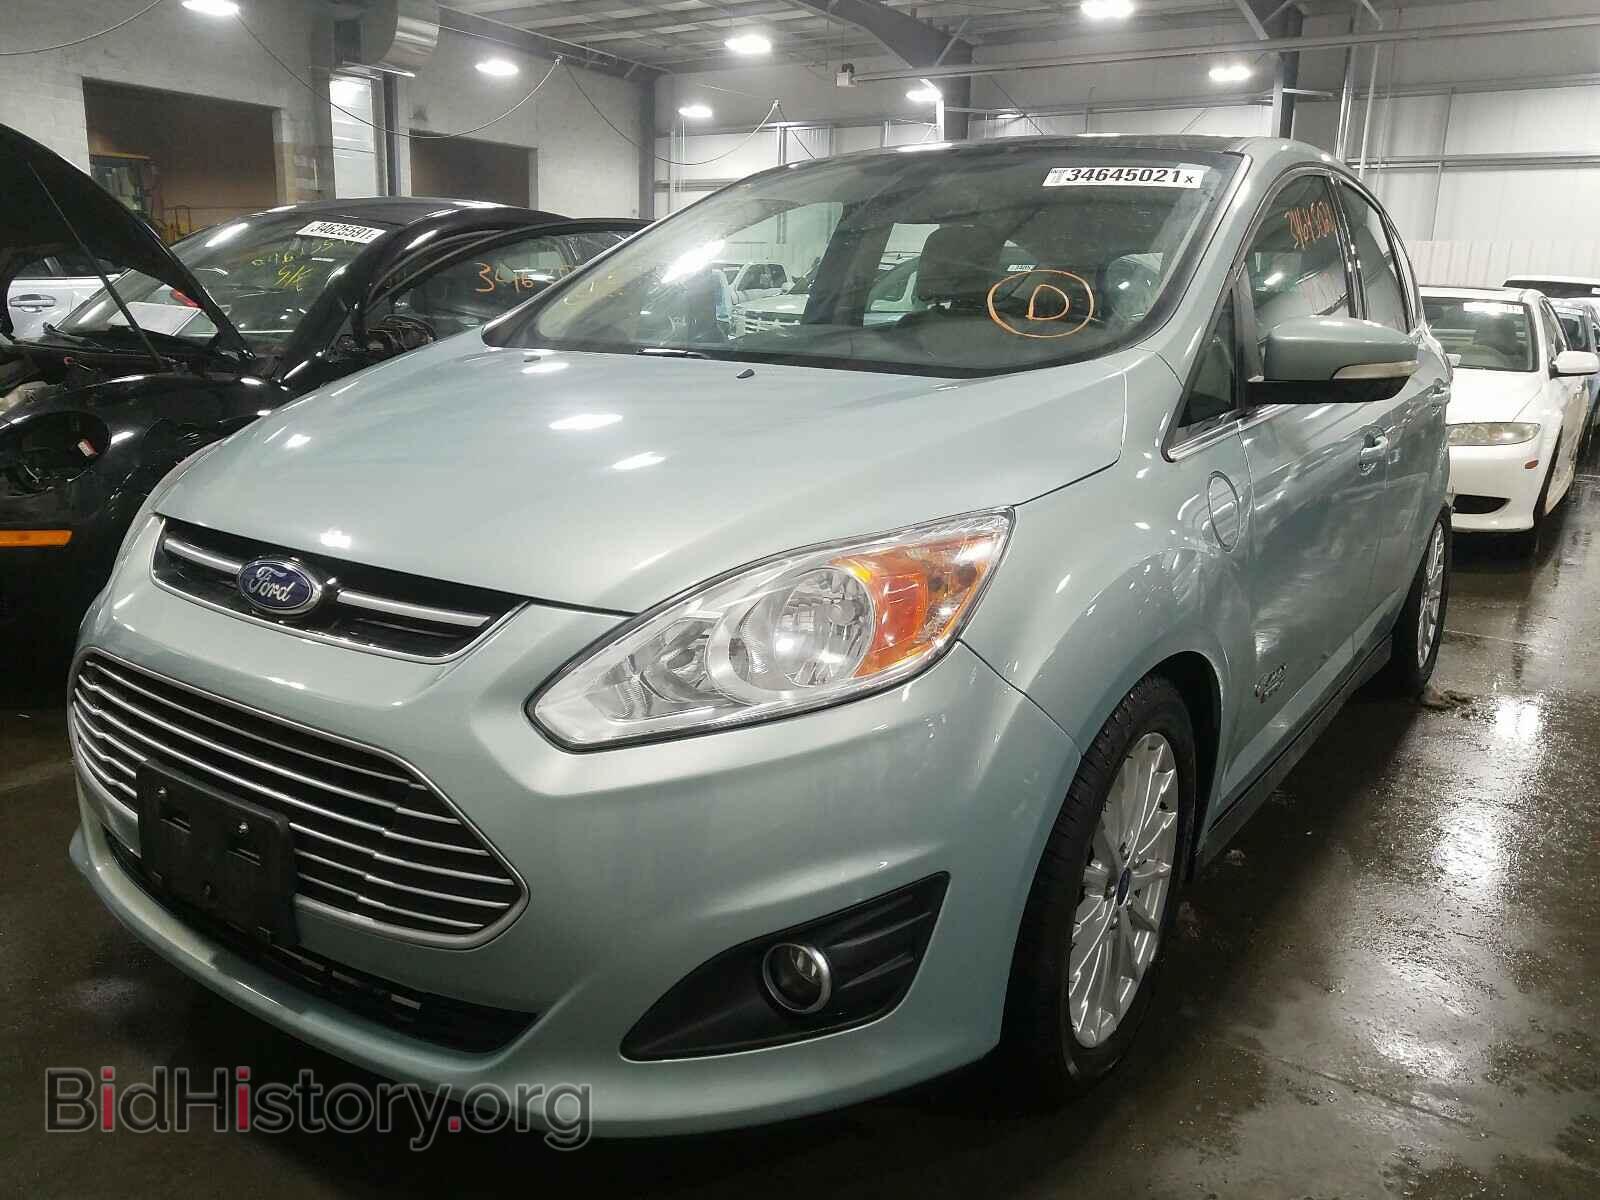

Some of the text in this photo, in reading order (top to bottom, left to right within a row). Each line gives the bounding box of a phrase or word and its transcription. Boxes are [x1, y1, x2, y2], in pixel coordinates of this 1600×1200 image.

[1066, 168, 1181, 183] 34645021
[310, 222, 373, 239] 34625591
[249, 566, 296, 601] Ford
